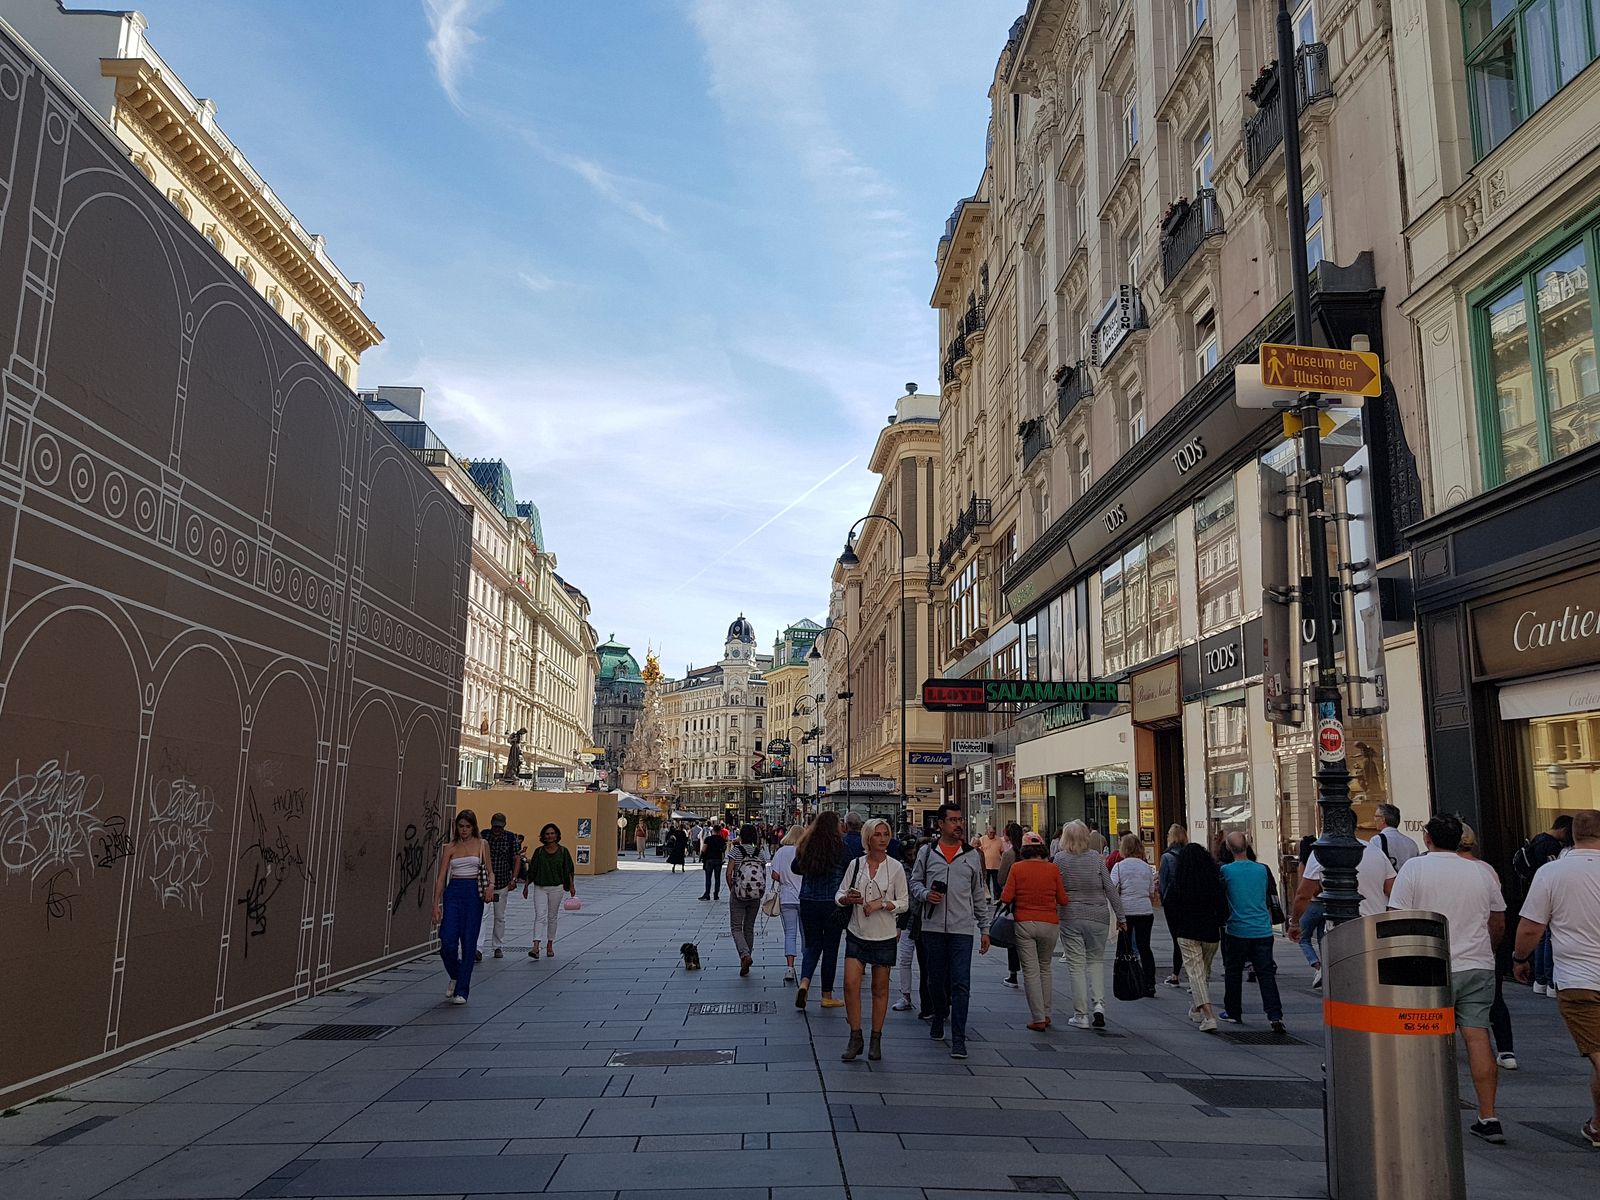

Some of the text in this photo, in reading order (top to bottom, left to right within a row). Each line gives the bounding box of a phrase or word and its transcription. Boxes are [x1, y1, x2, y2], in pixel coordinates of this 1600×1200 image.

[1120, 285, 1131, 329] PENSION
[1286, 352, 1358, 371] Museum der
[1293, 370, 1353, 387] Illusionen
[1205, 643, 1235, 674] TOD'S
[927, 689, 982, 700] LLOYD
[986, 682, 1118, 701] SALAMANDER
[1322, 732, 1339, 740] wien
[958, 743, 982, 751] Wolford
[923, 754, 949, 763] Tchibo
